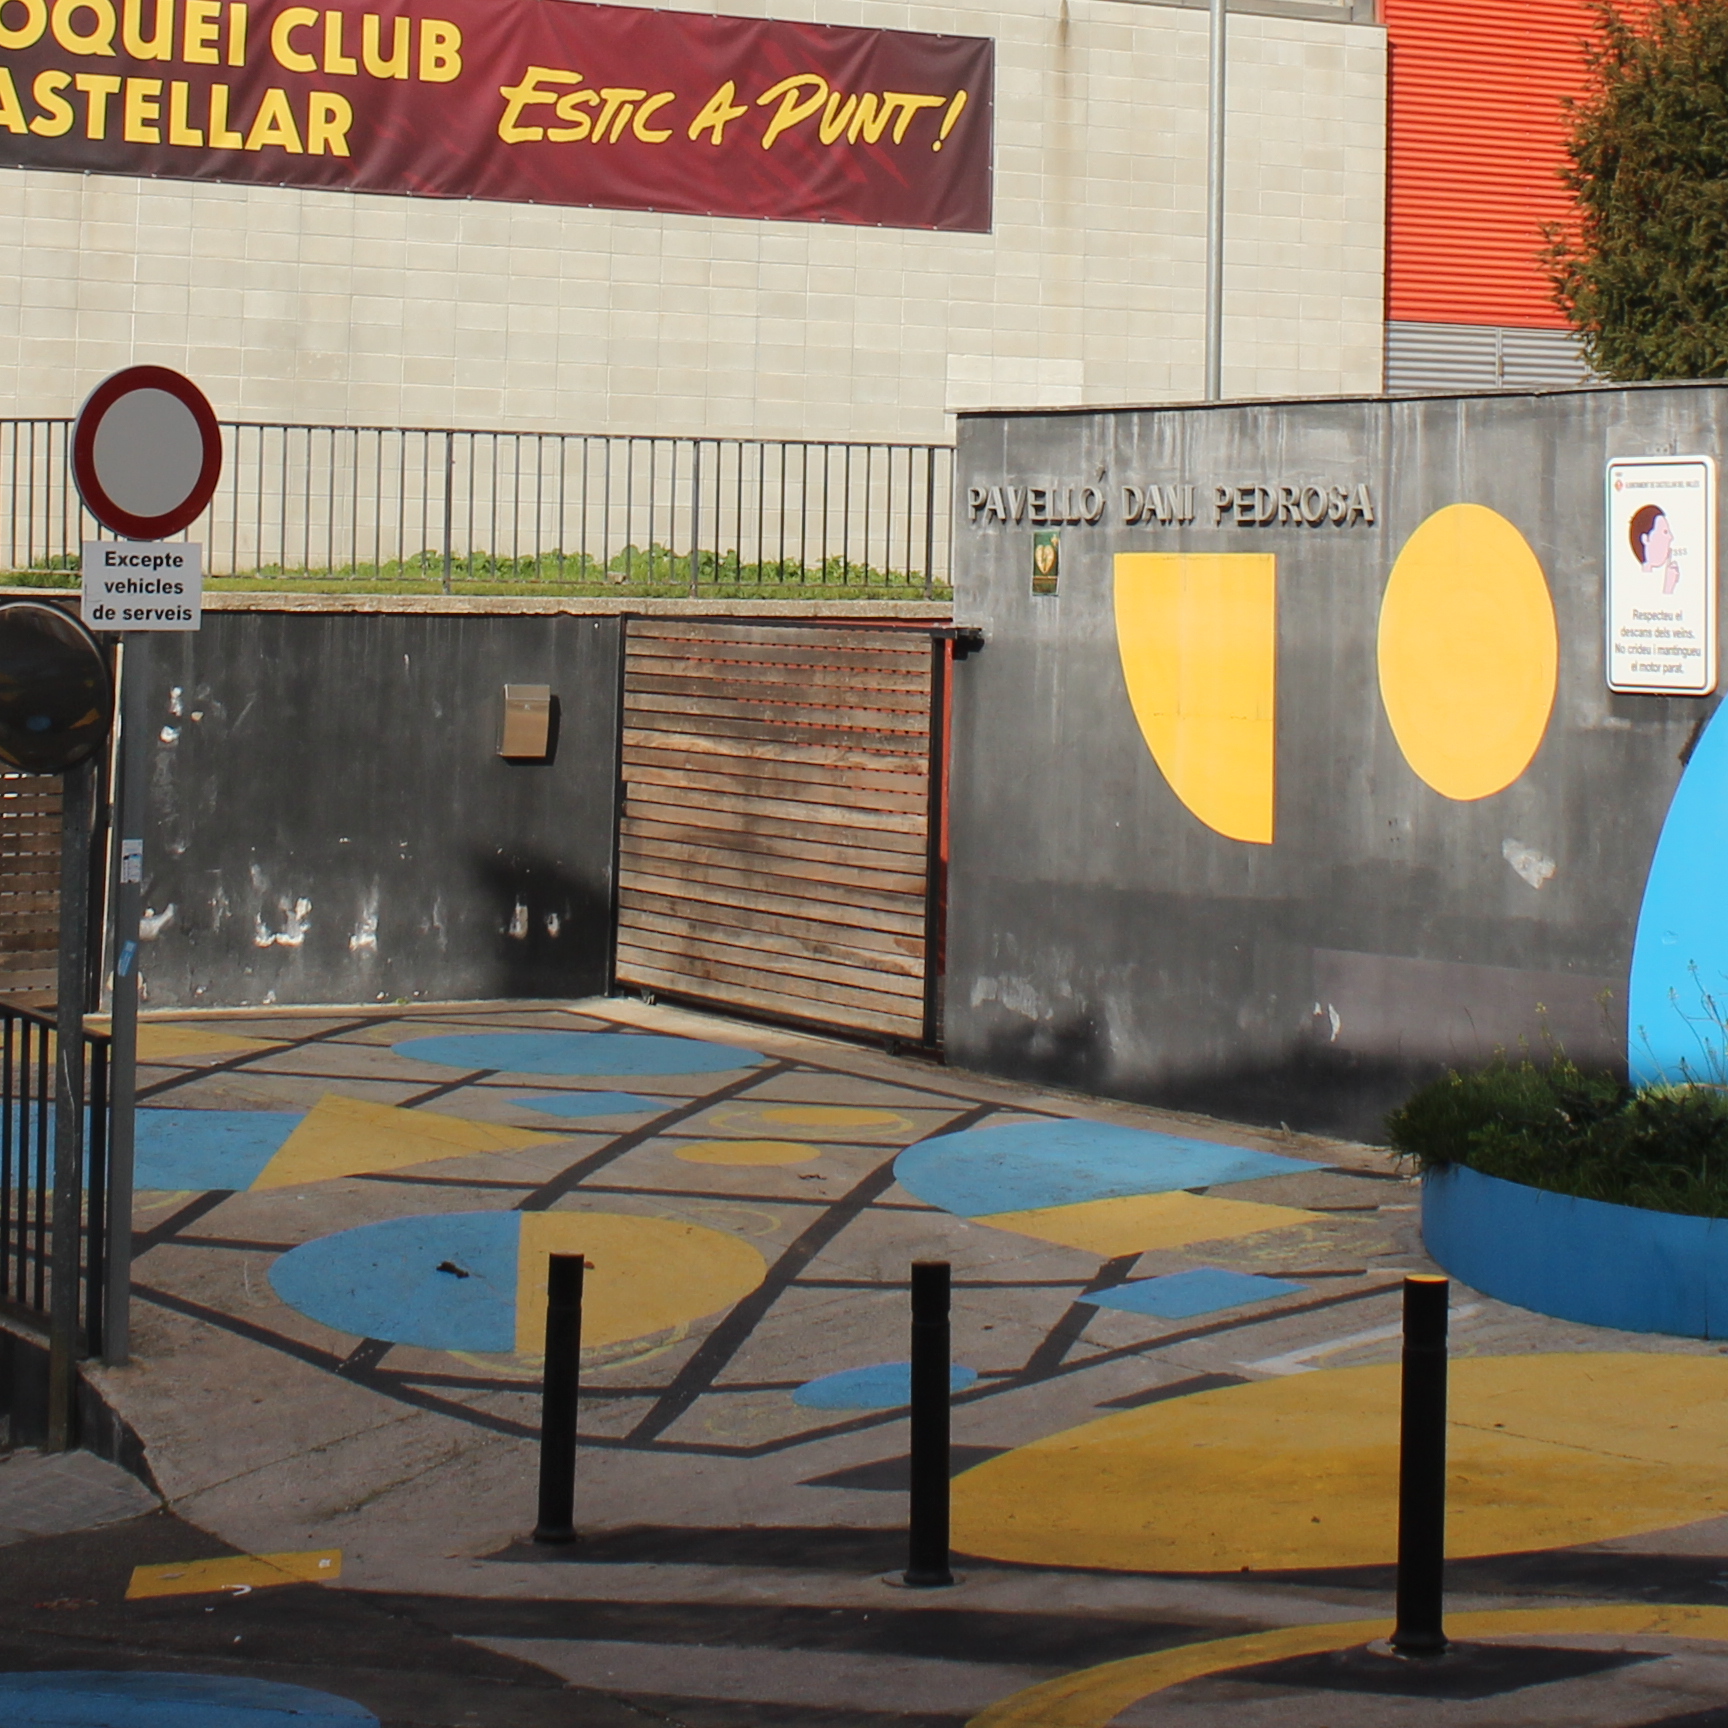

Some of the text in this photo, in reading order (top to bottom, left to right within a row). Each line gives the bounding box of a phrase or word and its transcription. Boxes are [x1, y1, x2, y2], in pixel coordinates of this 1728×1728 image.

[271, 6, 463, 84] CLUB
[687, 79, 749, 146] A
[967, 465, 1374, 526] PAVELLÓ DANI PEDROSA
[104, 550, 184, 571] Excepte
[104, 578, 184, 594] vehicles
[92, 604, 192, 620] de serveis
[1632, 609, 1683, 623] Respecteu el
[1620, 626, 1653, 638] descans
[1654, 627, 1671, 638] dels
[1615, 642, 1626, 654] No
[1627, 643, 1652, 655] crideu
[1657, 645, 1701, 659] mantingueu
[1631, 660, 1638, 672] el
[1639, 662, 1662, 672] motor
